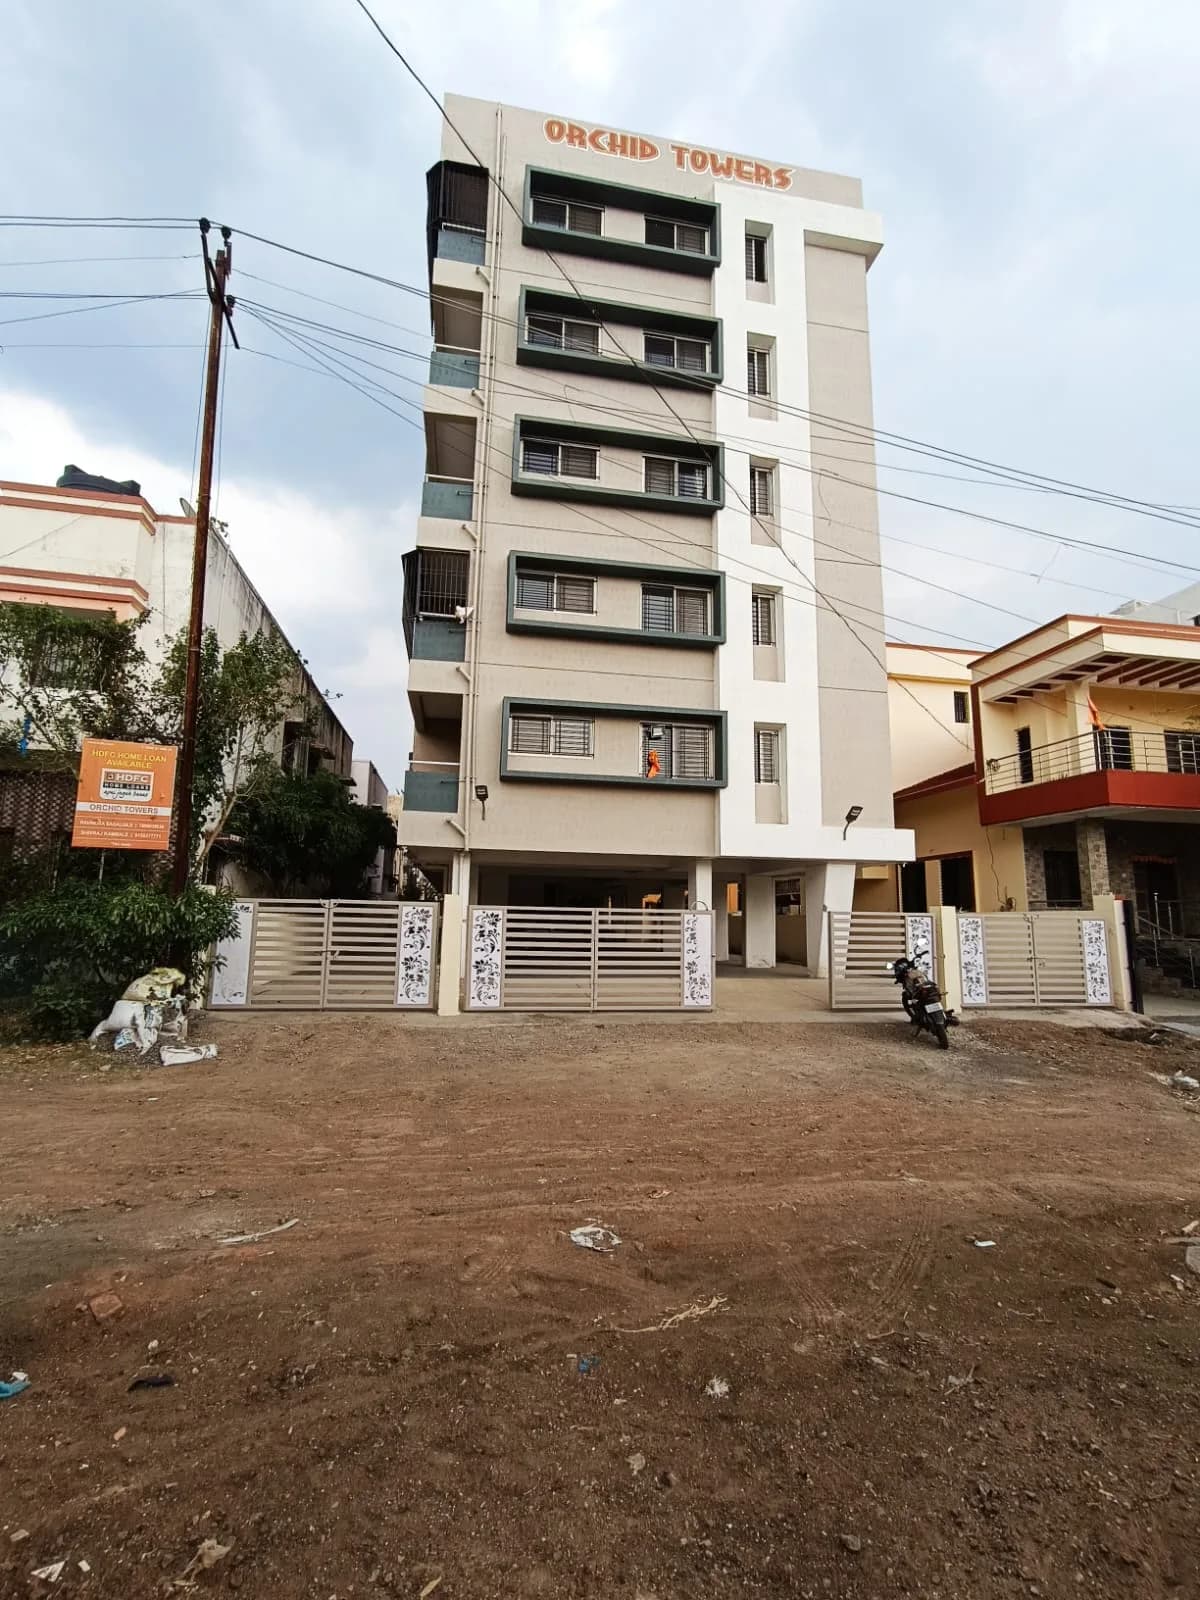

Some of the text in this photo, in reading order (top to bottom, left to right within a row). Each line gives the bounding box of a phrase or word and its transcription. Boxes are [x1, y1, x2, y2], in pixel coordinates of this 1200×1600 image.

[543, 117, 796, 191] ORCHID TOWERS
[92, 749, 167, 763] HDFC HOME LOAN
[106, 759, 153, 769] AVAILABLE
[116, 773, 149, 783] HDFC
[89, 803, 159, 814] ORCHID TOWERS
